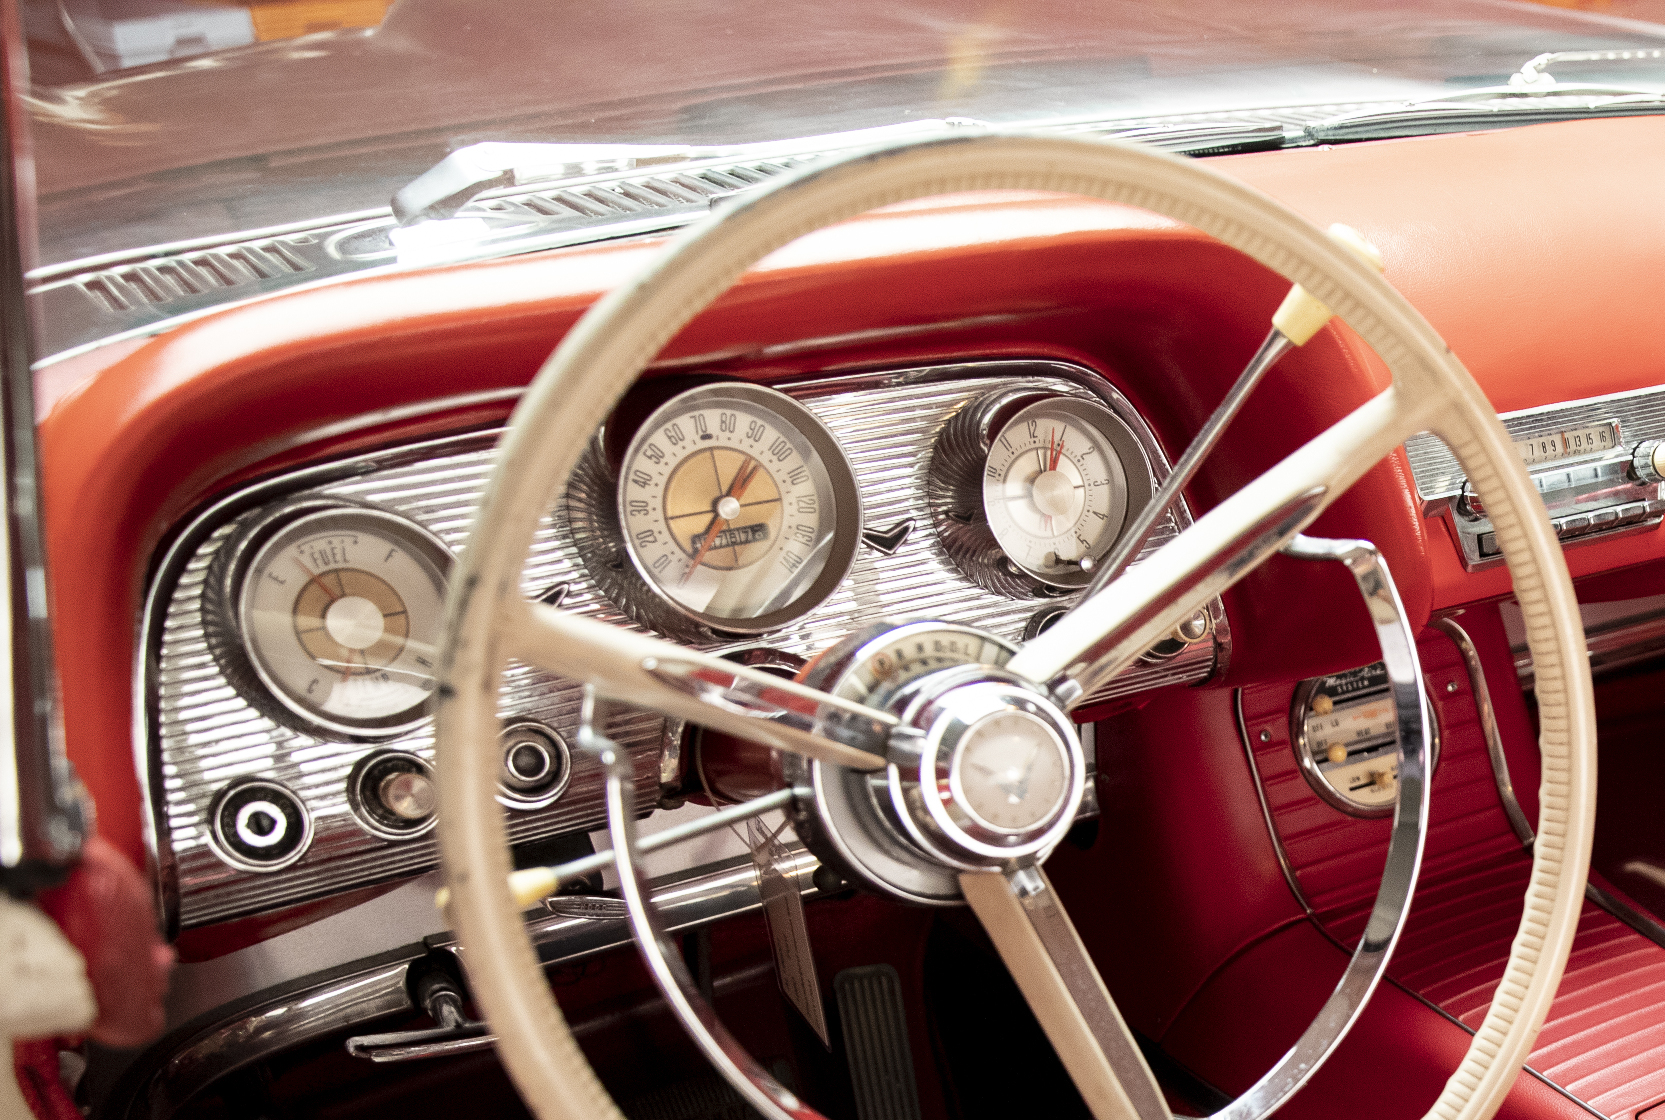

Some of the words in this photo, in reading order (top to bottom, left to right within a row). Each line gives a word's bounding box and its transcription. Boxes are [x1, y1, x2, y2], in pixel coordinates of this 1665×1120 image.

[689, 413, 708, 435] 70
[720, 412, 737, 434] 80
[746, 420, 766, 442] 90
[1026, 419, 1038, 439] 12
[663, 423, 686, 446] 60
[999, 433, 1013, 452] 11
[1529, 443, 1534, 456] 7
[1541, 441, 1548, 454] 8
[1551, 440, 1557, 453] 9
[1574, 435, 1582, 448] 13
[1585, 433, 1594, 446] 15
[1598, 430, 1607, 443] 16
[643, 443, 665, 465] 50
[768, 436, 793, 462] 100
[1080, 445, 1095, 461] 2
[631, 469, 653, 489] 40
[787, 465, 810, 486] 110
[986, 465, 998, 479] 10
[1092, 478, 1110, 487] 3
[629, 500, 649, 516] 30
[795, 494, 817, 514] 120
[1092, 509, 1109, 521] 4
[636, 529, 658, 549] 20
[793, 524, 815, 548] 130
[1077, 535, 1091, 550] 5
[310, 545, 350, 570] FUEL
[384, 548, 400, 563] F
[653, 554, 673, 574] 10
[268, 571, 287, 586] E
